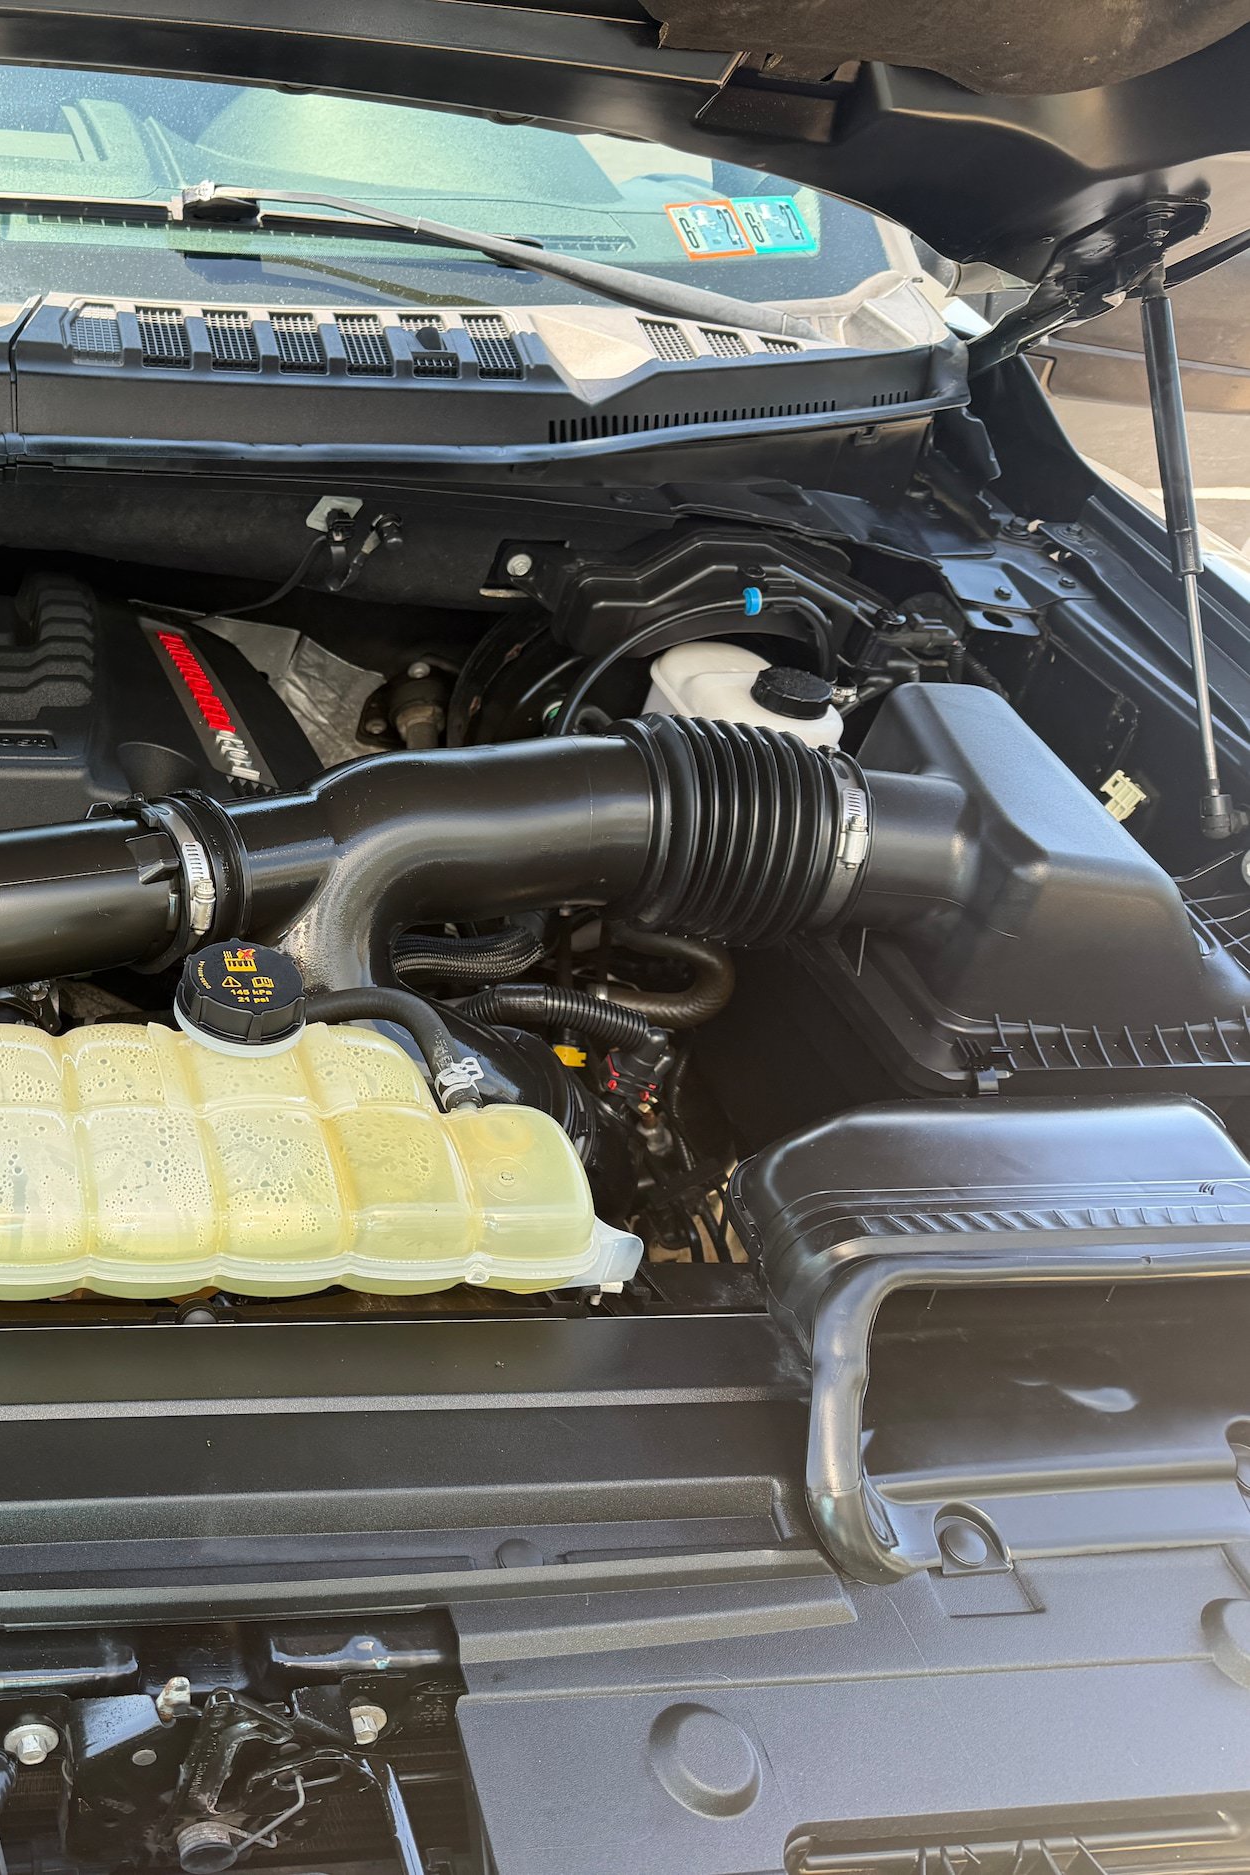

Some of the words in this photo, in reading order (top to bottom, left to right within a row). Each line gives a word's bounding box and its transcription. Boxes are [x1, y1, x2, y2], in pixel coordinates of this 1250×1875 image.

[679, 217, 699, 249] 6
[745, 212, 765, 243] 6
[253, 996, 270, 1004] psi
